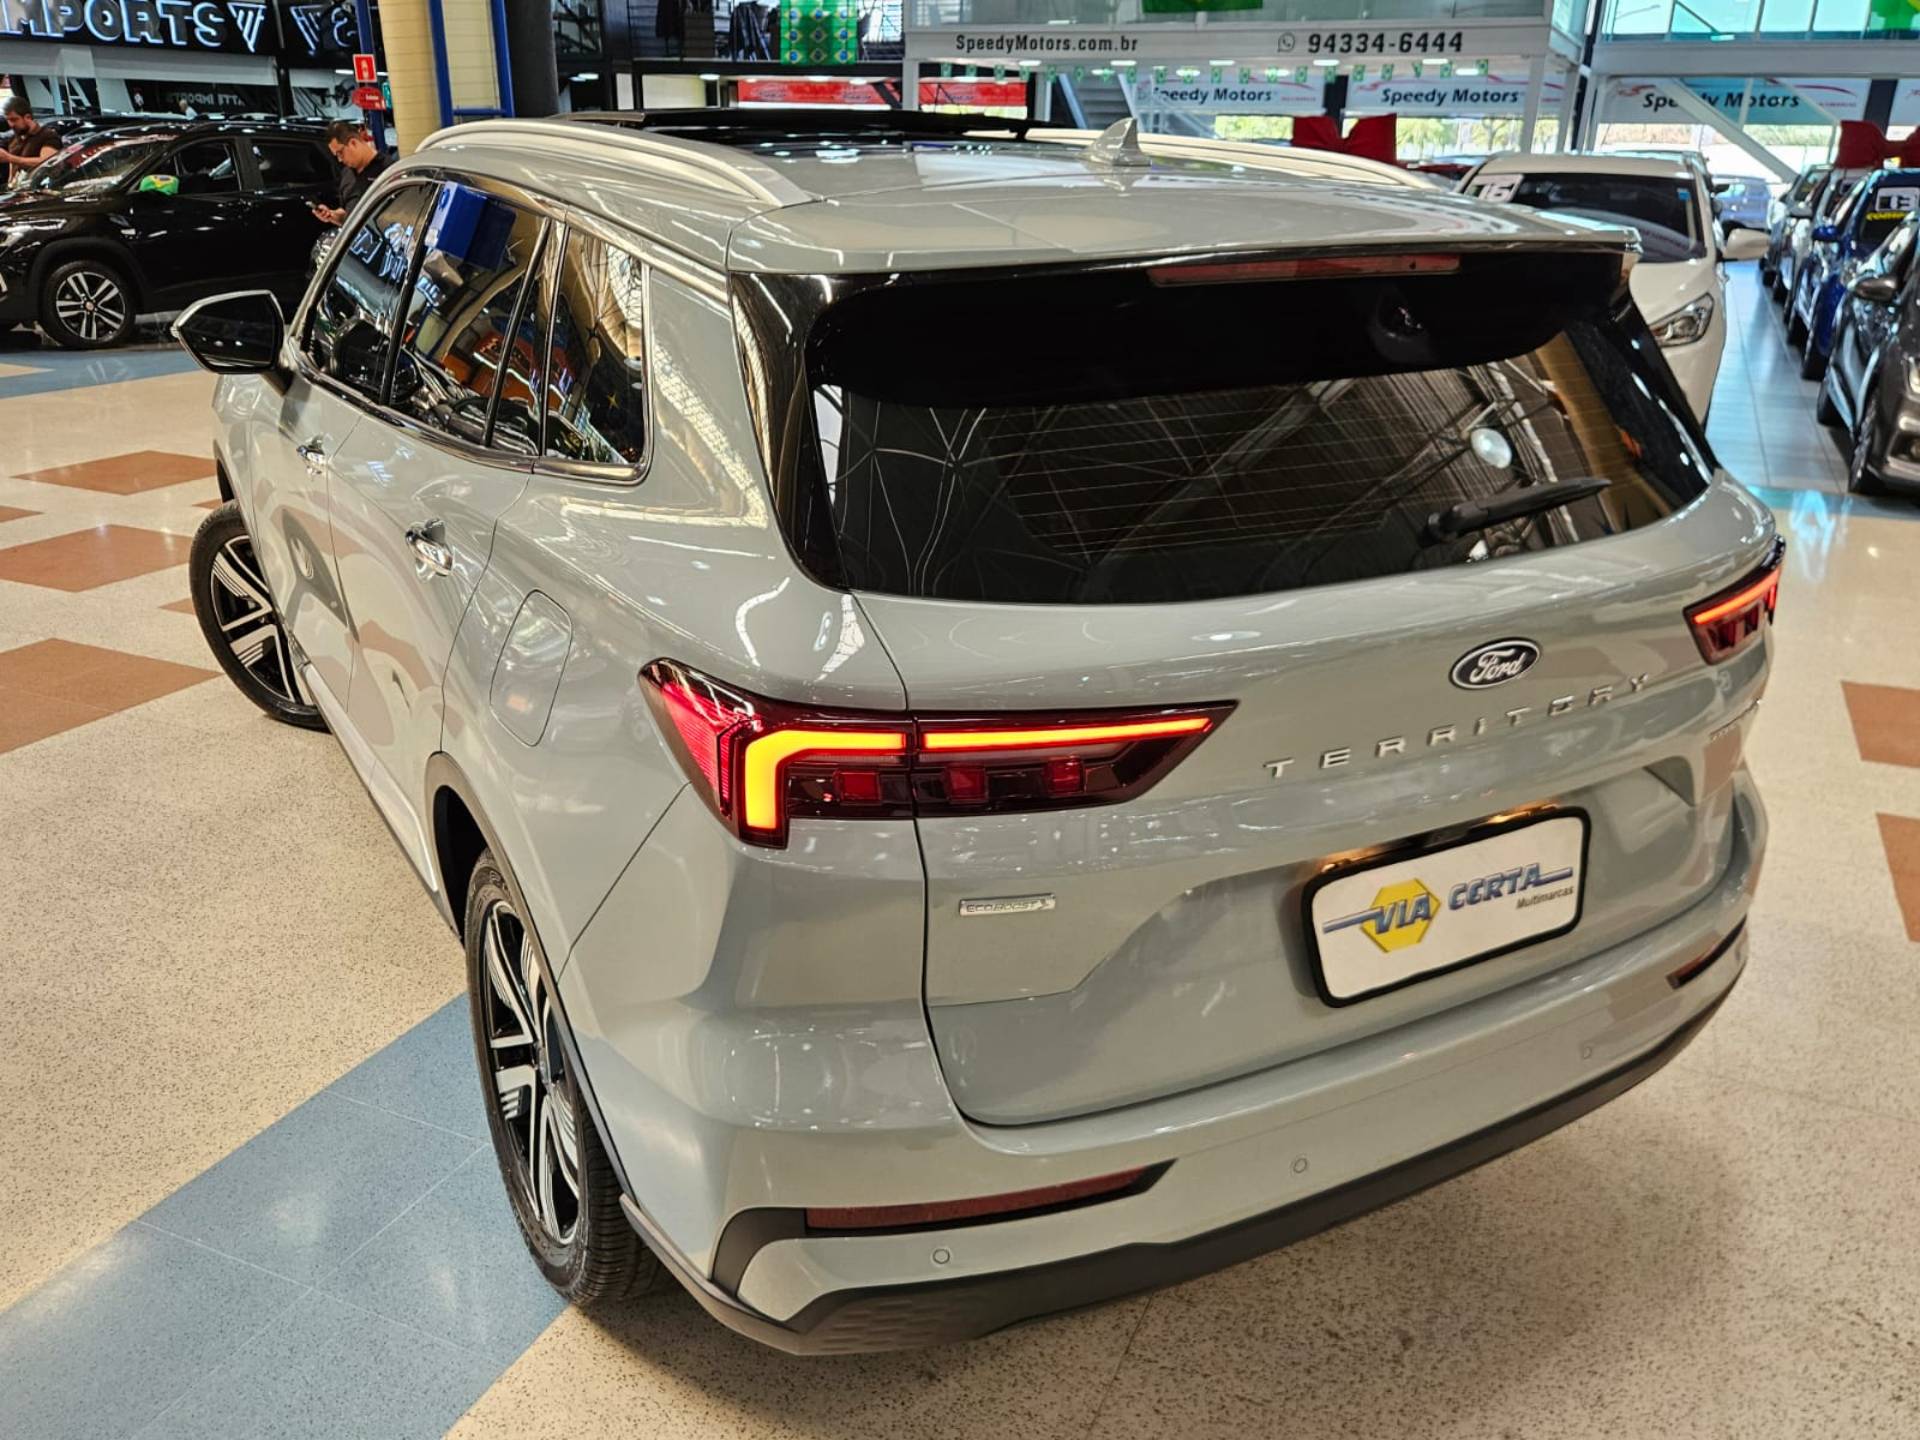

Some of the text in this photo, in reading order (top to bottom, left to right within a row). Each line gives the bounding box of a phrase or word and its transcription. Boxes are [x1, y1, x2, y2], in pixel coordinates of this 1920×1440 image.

[0, 0, 227, 46] MPORTS
[955, 34, 1139, 53] SpeedyMotors.com.br
[1307, 31, 1464, 53] 94334-6444
[1153, 86, 1272, 105] eedy Motors
[1381, 88, 1519, 107] Speedy Motors
[1642, 92, 1719, 113] Spey
[1469, 648, 1527, 683] Ford
[1264, 674, 1649, 779] TERRITORY
[1375, 863, 1543, 935] VIA CERTA
[1516, 886, 1574, 909] Multimarcas
